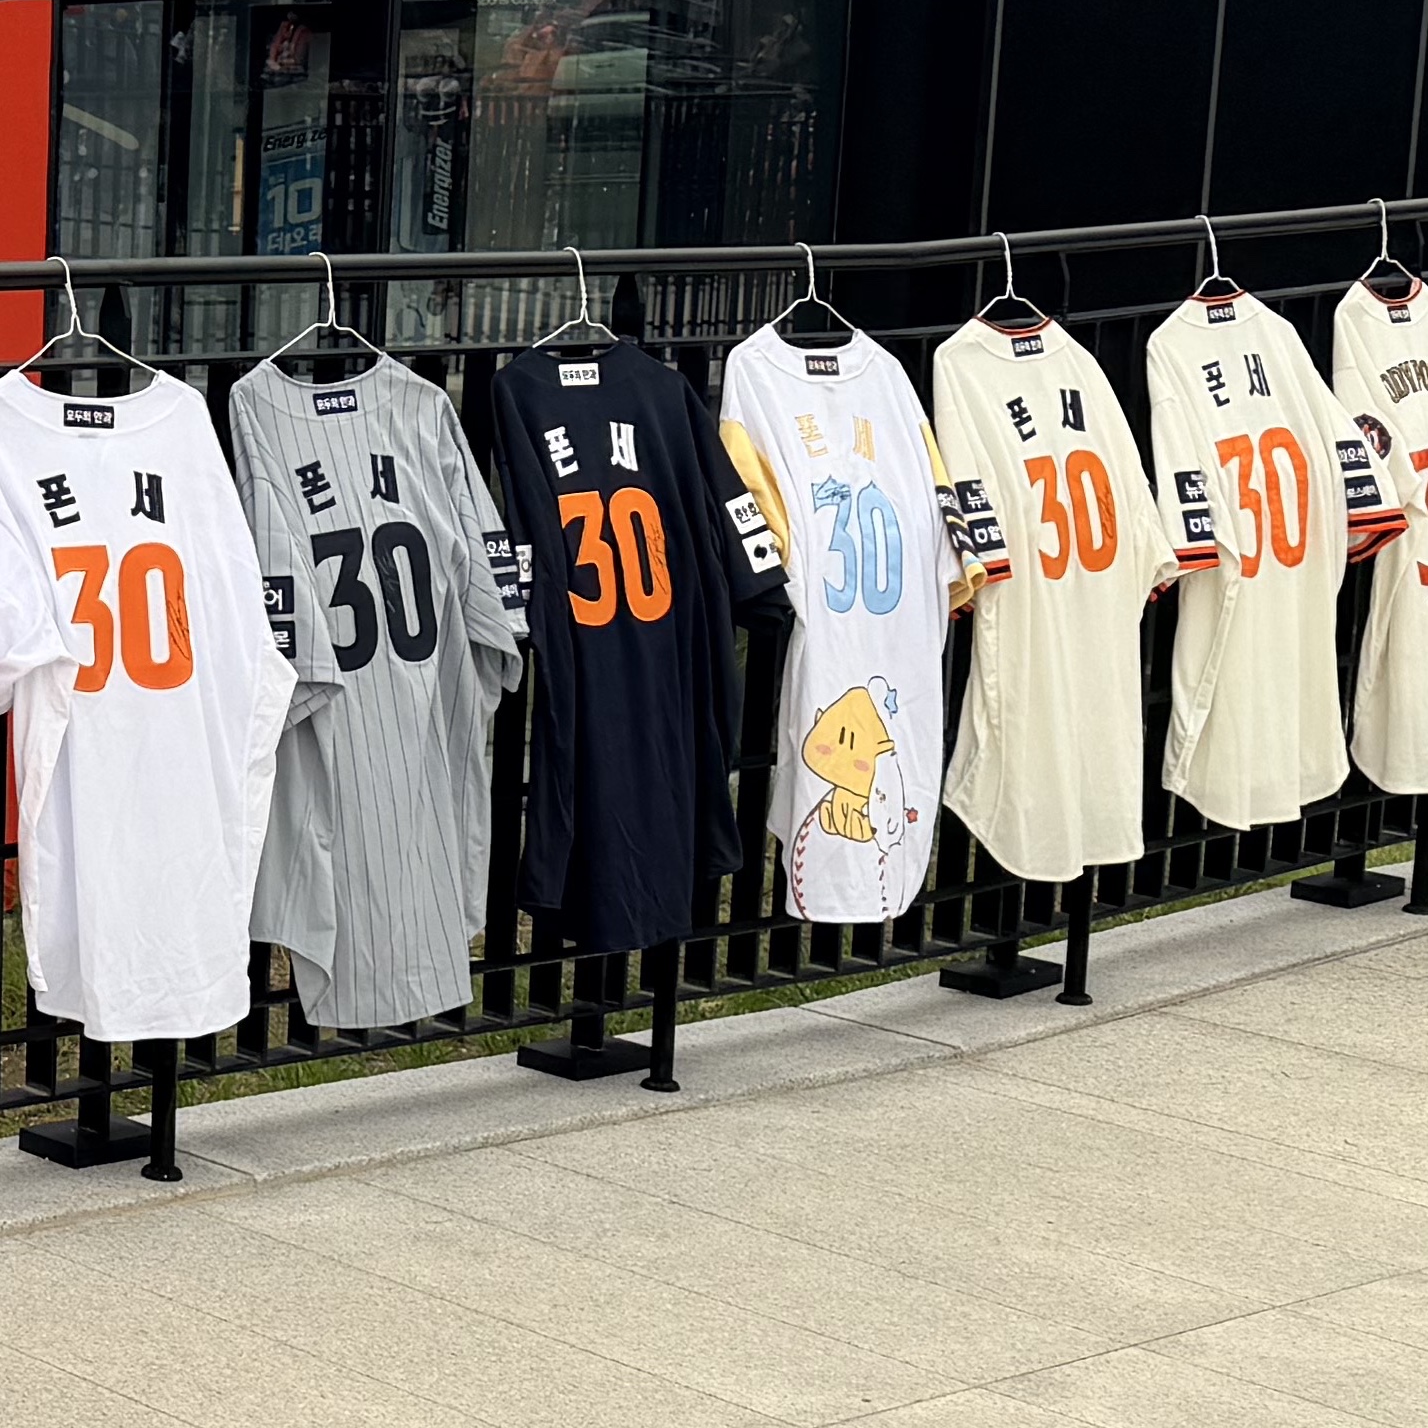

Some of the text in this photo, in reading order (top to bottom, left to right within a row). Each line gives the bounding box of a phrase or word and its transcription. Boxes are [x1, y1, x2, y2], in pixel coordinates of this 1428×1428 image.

[266, 177, 324, 229] 10
[427, 137, 454, 231] Energizer
[558, 487, 672, 627] 30
[811, 474, 903, 616] 30
[1024, 449, 1118, 581] 30
[1215, 427, 1309, 579] 30
[52, 542, 194, 693] 30
[310, 521, 438, 672] 30
